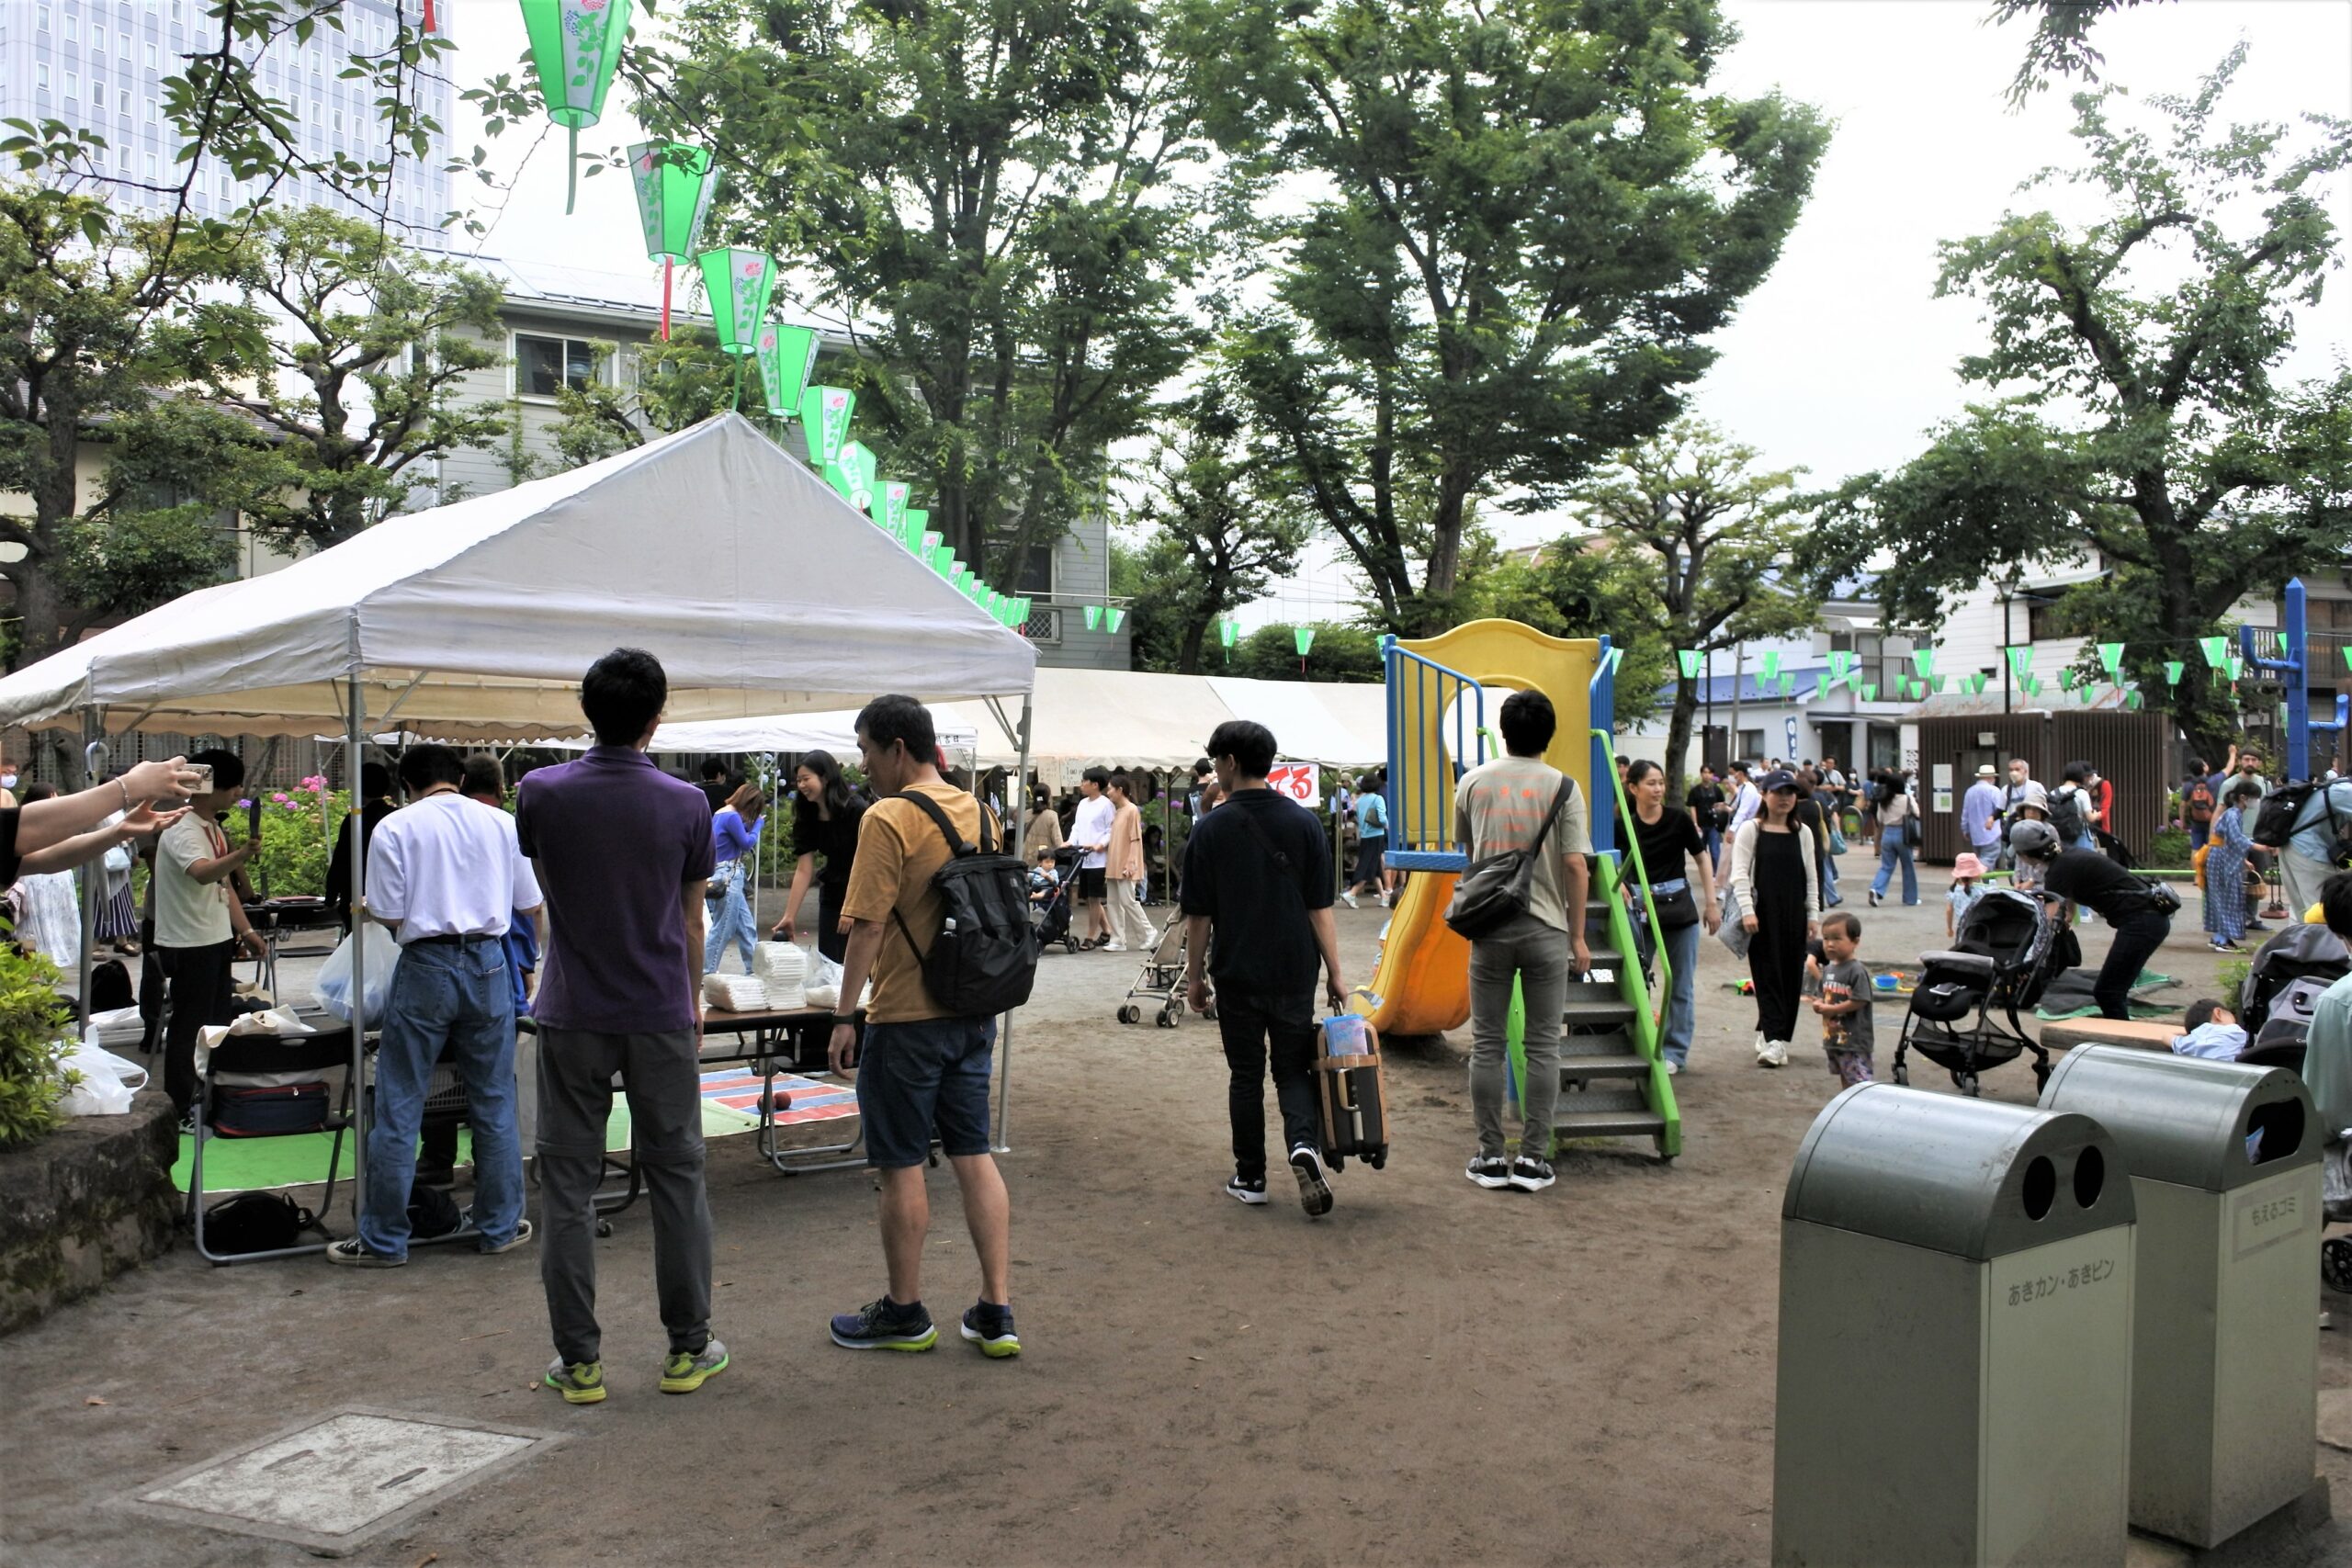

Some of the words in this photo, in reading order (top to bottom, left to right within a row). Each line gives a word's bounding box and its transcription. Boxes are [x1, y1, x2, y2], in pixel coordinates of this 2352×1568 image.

[2252, 1197, 2296, 1226] もえるゴミ
